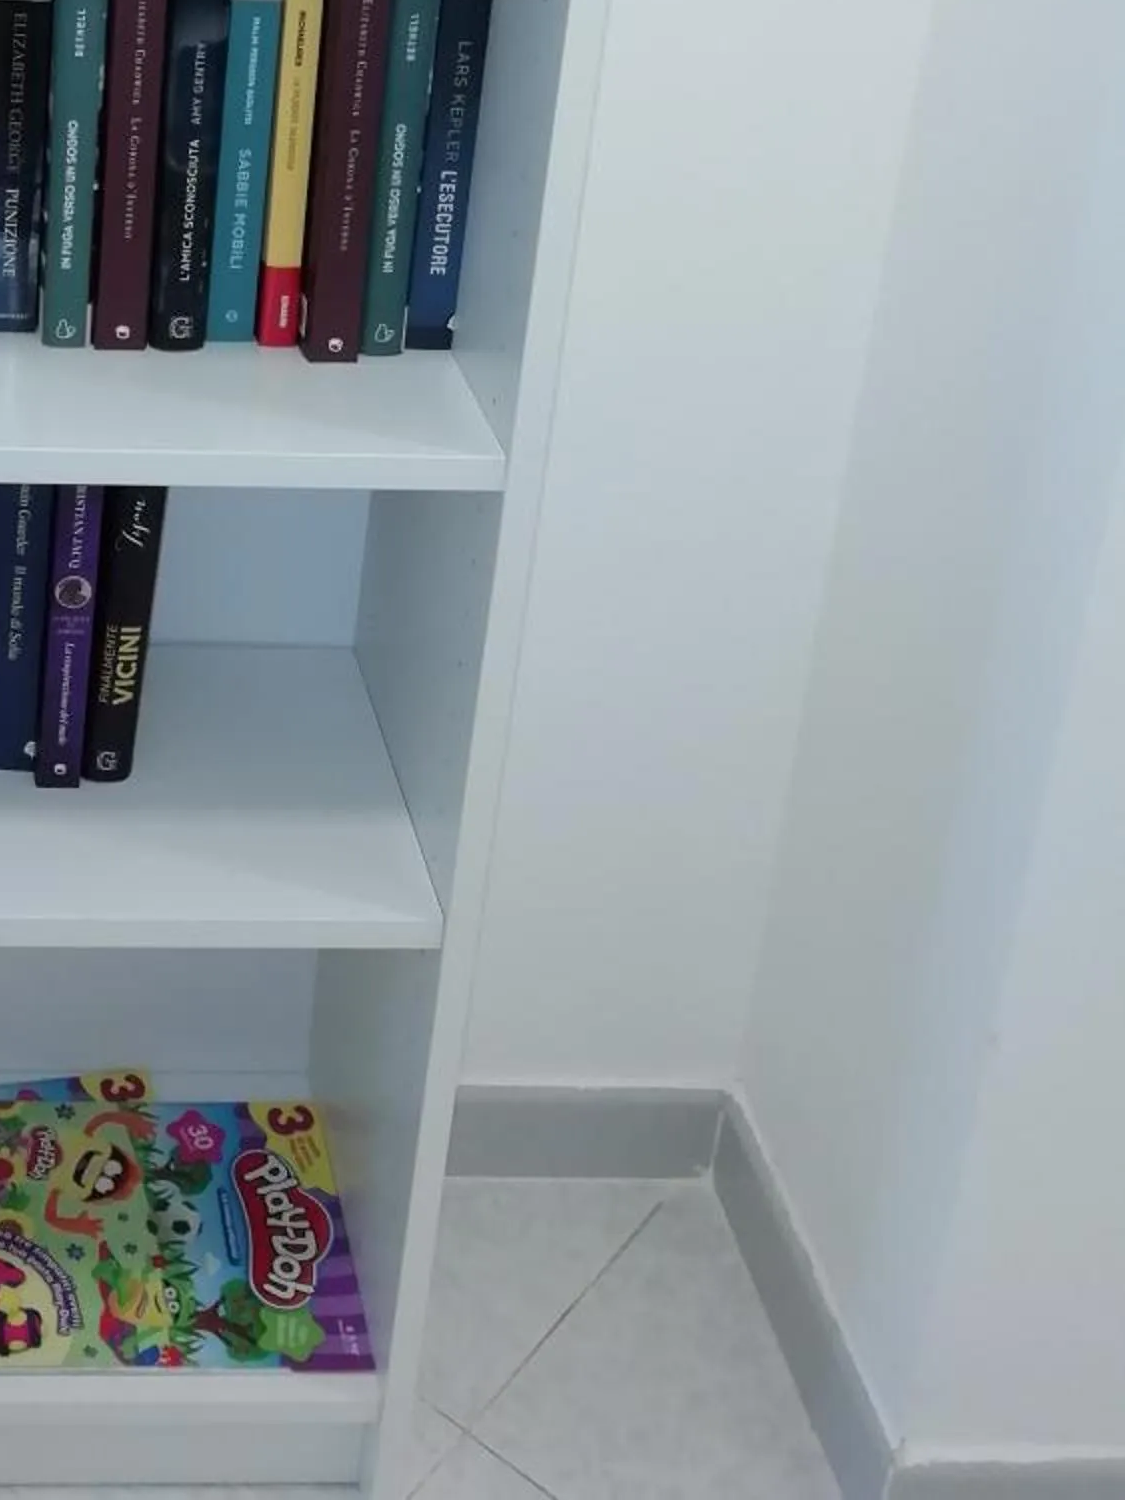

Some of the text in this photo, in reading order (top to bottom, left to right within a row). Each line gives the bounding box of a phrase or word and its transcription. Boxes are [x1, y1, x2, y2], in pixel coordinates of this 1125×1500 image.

[9, 12, 28, 104] ELIZABETH
[192, 41, 206, 94] GENTRY
[66, 119, 79, 164] SOGNO
[444, 40, 474, 163] LARS KEPLER
[392, 123, 407, 168] SOGNO
[2, 188, 21, 277] PUNIZIONE
[63, 185, 76, 221] VERSO
[179, 139, 201, 281] L'AMICA SCONOSCIUTA
[230, 148, 252, 269] SABBIE MOBILI
[431, 170, 458, 276] L'ESECUTORE
[98, 623, 118, 703] FINALMENTE
[112, 625, 142, 706] VICINI
[99, 1074, 146, 1102] 3
[268, 1105, 315, 1136] 3
[186, 1124, 214, 1151] 30
[243, 1154, 319, 1300] Play-Doh
